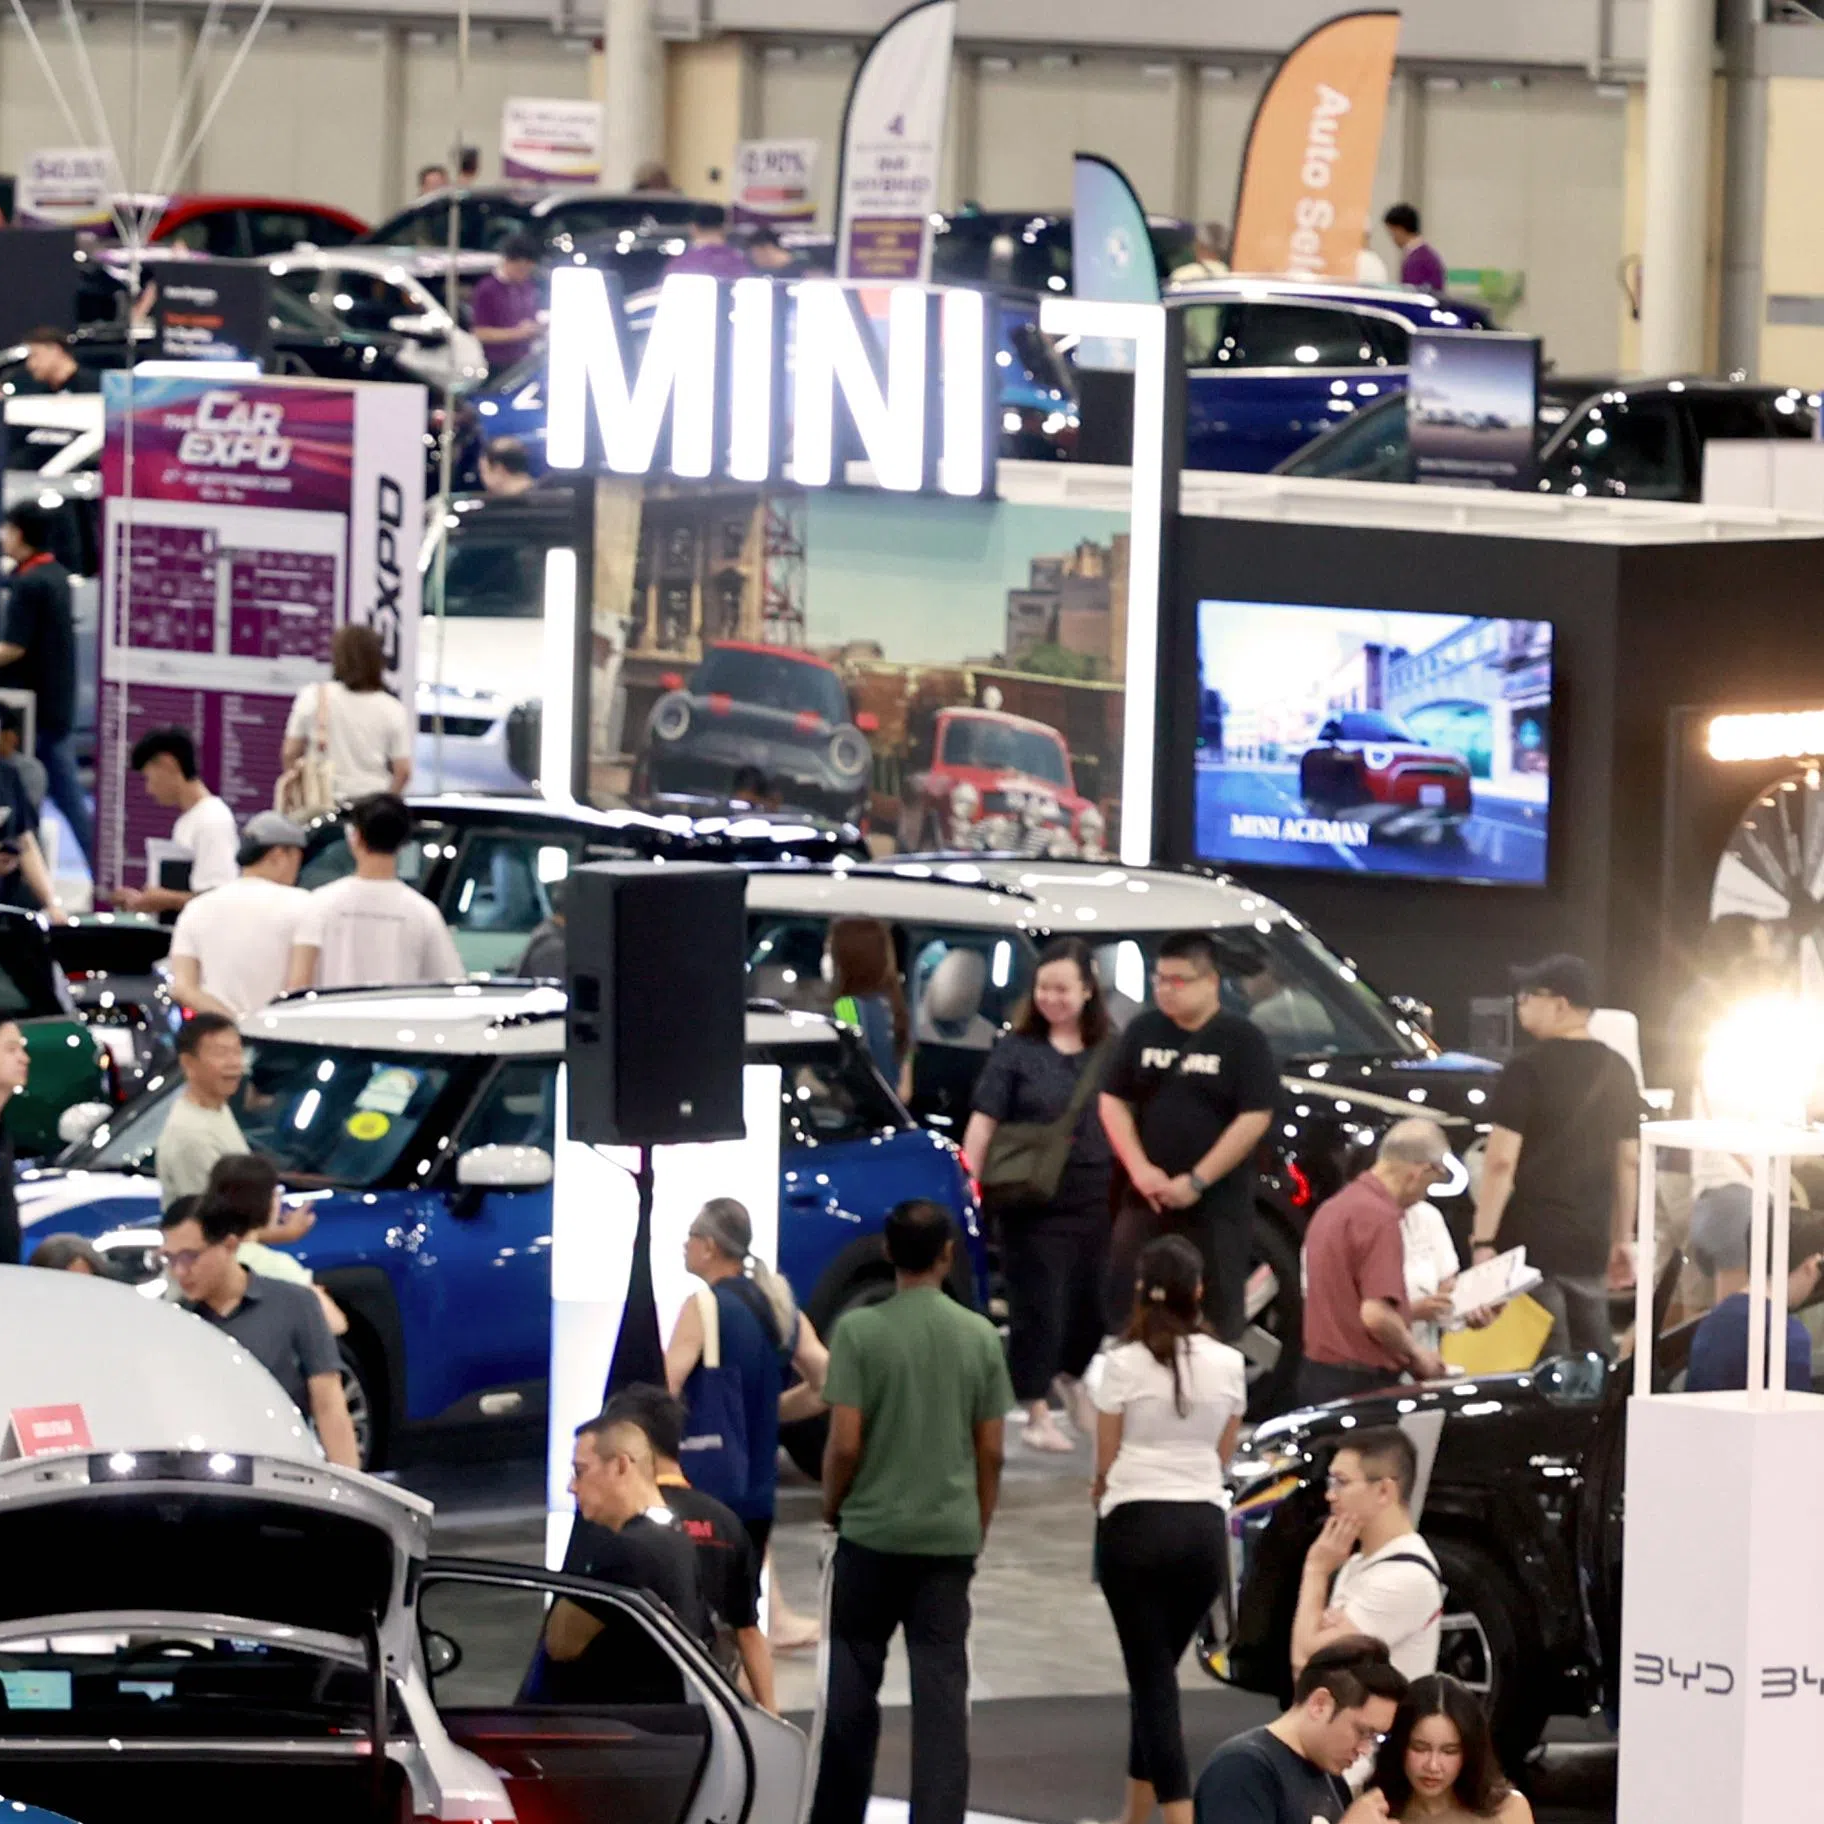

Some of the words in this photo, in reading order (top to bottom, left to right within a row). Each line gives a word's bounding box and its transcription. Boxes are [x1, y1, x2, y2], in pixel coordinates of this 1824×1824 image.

[1301, 83, 1352, 188] Auto
[545, 265, 985, 497] MINI
[196, 389, 286, 436] CAR
[178, 431, 294, 471] EXPO
[1230, 812, 1279, 840] MINI
[1280, 815, 1369, 846] ACEMAN
[1633, 1652, 1736, 1696] BYD
